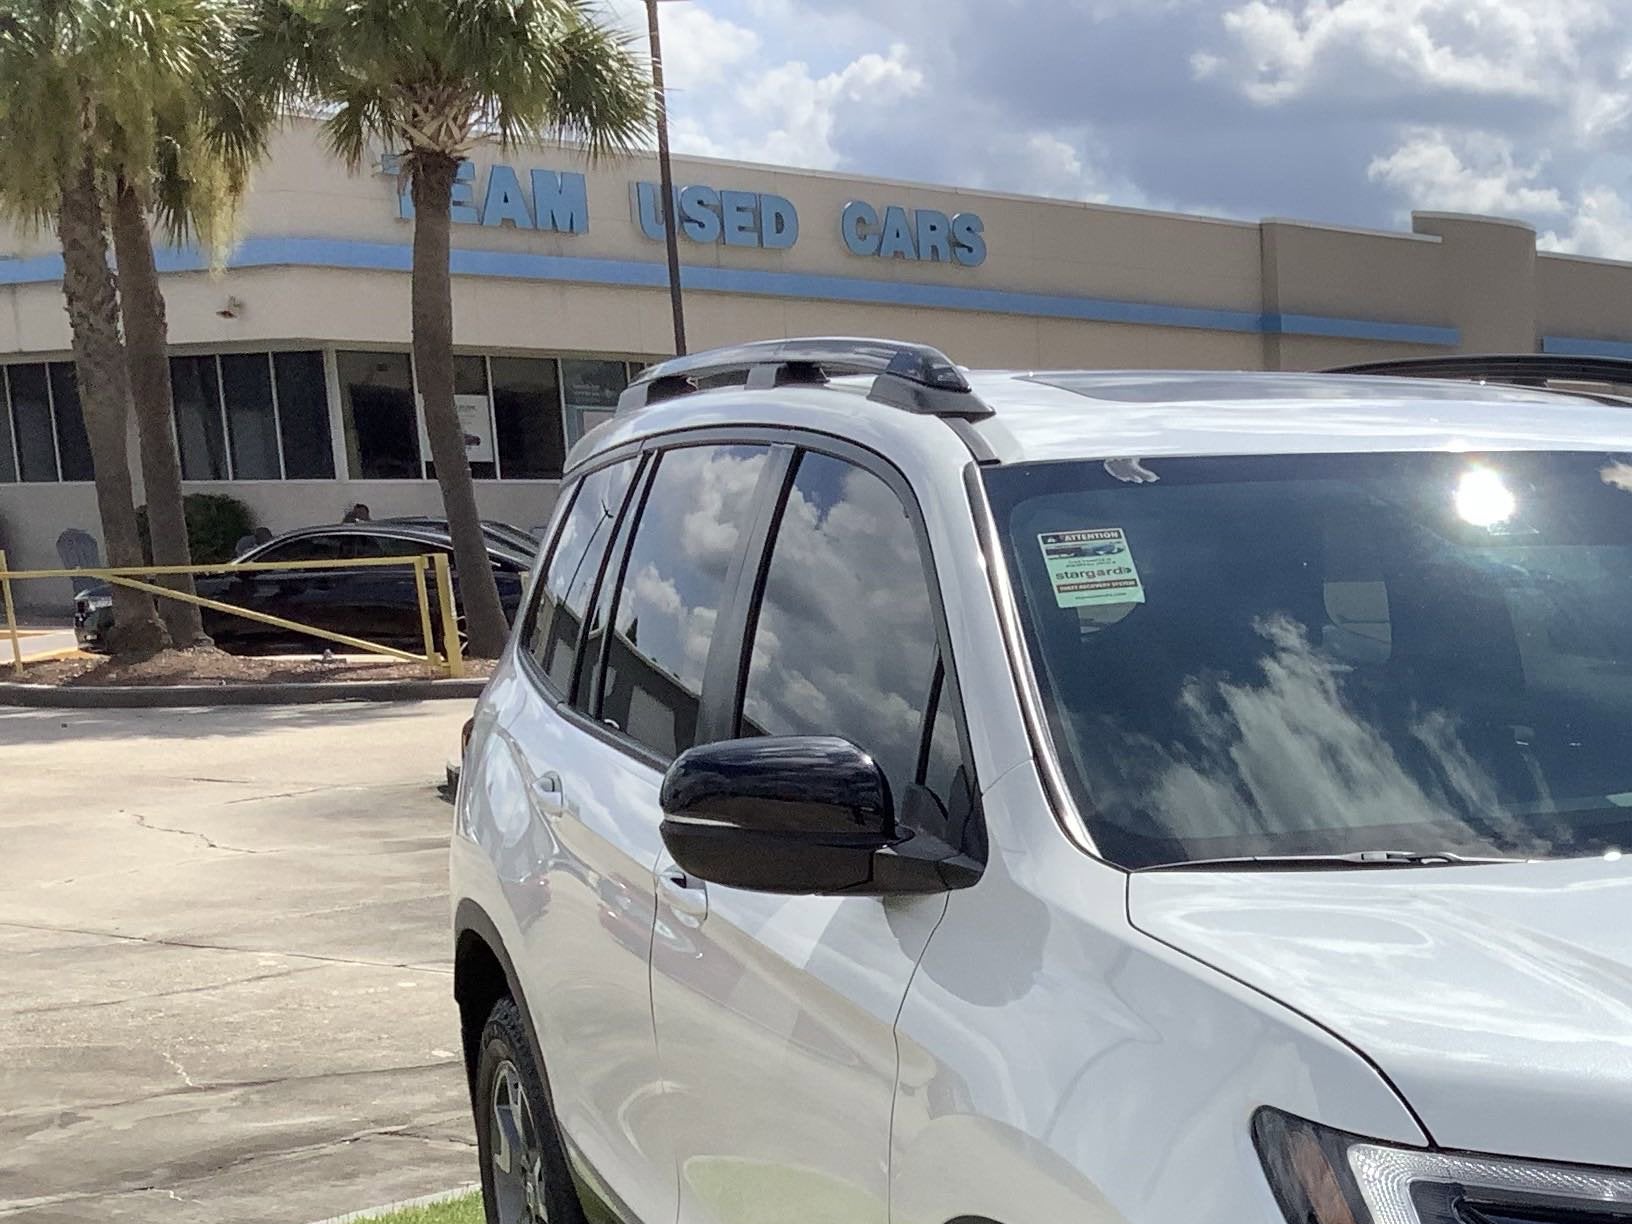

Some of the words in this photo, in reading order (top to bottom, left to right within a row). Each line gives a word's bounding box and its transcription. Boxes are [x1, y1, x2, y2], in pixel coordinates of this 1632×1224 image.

[634, 181, 799, 249] USED
[841, 200, 988, 267] CARS
[1064, 531, 1119, 542] ATTENTION
